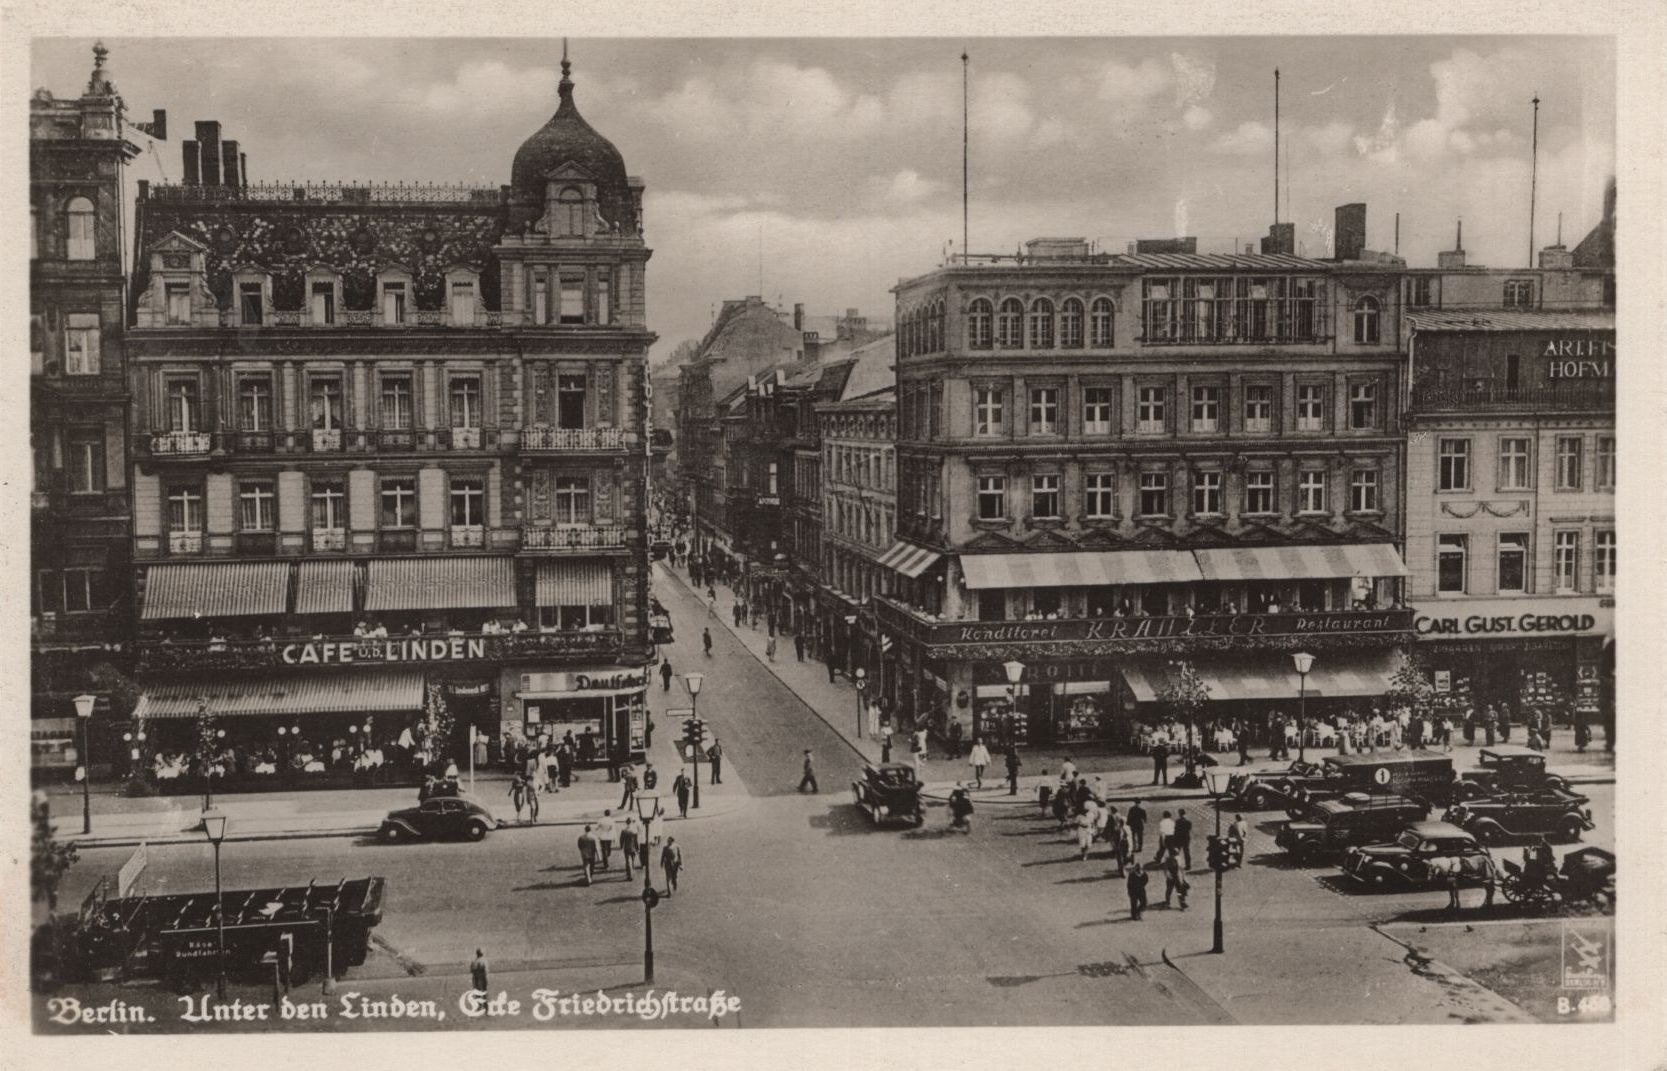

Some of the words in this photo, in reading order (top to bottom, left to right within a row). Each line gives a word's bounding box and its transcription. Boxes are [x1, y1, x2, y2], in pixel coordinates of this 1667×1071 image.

[960, 624, 1058, 641] Konditorei
[1086, 616, 1267, 640] KRANZLER
[1295, 616, 1390, 631] Restaurant
[1414, 616, 1462, 635] CARL
[1519, 613, 1597, 632] GEROLD
[282, 643, 353, 664] CAFE
[386, 639, 485, 660] LINDEN
